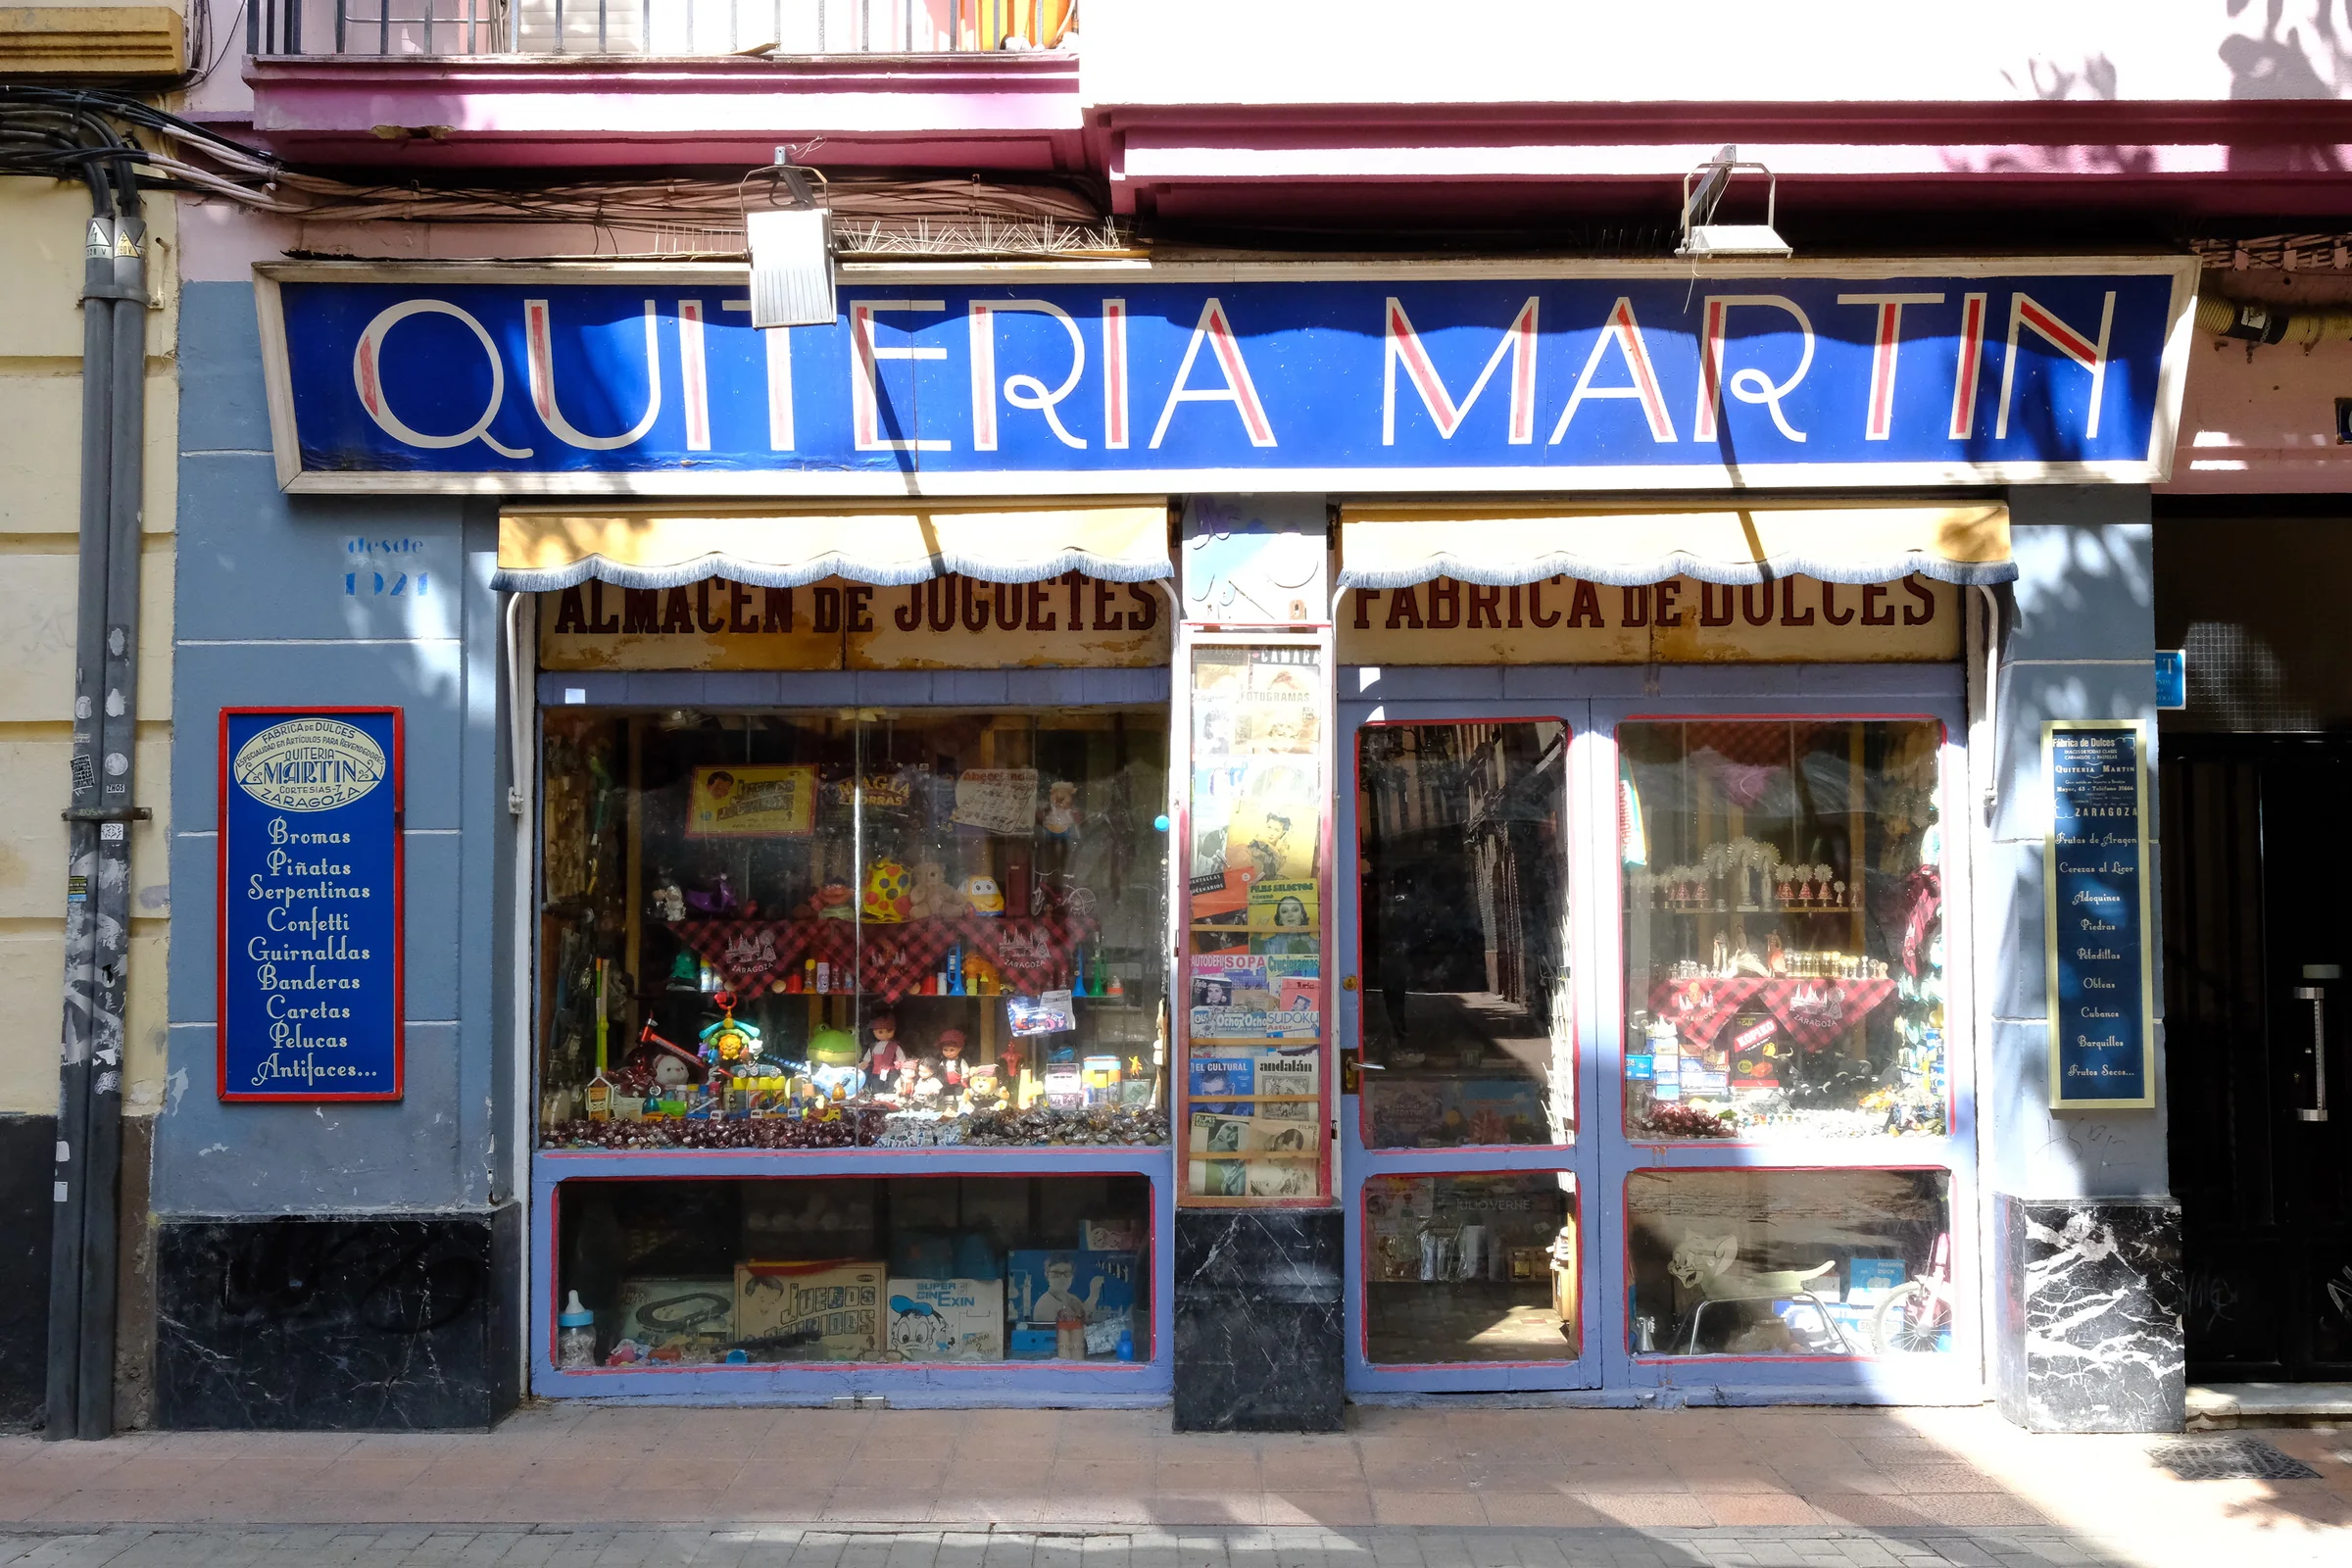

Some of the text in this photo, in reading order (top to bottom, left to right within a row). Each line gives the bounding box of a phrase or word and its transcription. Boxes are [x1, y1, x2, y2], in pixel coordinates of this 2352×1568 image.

[352, 291, 2117, 459] QUITERIA MARTIN
[347, 537, 423, 555] desde
[555, 574, 1159, 634] ALMACEN DE JUGUETES
[1353, 567, 1936, 629] FABRICA DE DULCES
[1241, 691, 1310, 703] FOTOGRAMAS
[262, 723, 303, 744] FABRICA
[316, 722, 356, 739] DULCES
[2080, 738, 2089, 747] de
[2090, 737, 2116, 748] Dulces
[235, 742, 276, 767] ESPECIALIDAD
[322, 736, 339, 745] PARA
[339, 738, 386, 765] REVENDEDORES
[283, 747, 335, 761] QUITERIA
[264, 760, 358, 784] MARTIN
[2055, 764, 2135, 774] QUITERIA MARTIN
[839, 775, 910, 798] MAGIA
[261, 787, 362, 808] ZARAGOZA
[2075, 807, 2138, 817] ZARAGOZA
[268, 815, 351, 846] Bromas
[2054, 831, 2086, 847] Frutas
[2089, 832, 2100, 845] de
[267, 847, 352, 877] Piñatas
[2059, 860, 2134, 876] Cerezas al Licor
[247, 873, 370, 908] Serpentinas
[1250, 882, 1314, 894] FILMS SELECTOS
[2072, 890, 2121, 906] Adoquines
[267, 906, 350, 941] Confetti
[2080, 917, 2116, 931] Piedras
[247, 935, 370, 962] Guirnaldas
[2076, 947, 2121, 960] Peladillas
[731, 961, 774, 973] ZARAGOZA
[1004, 957, 1047, 969] ZARAGOZA
[1226, 956, 1266, 968] SOPA
[1267, 956, 1319, 973] Crucigramas
[257, 961, 361, 991] Banderas
[2082, 977, 2116, 990] Obleas
[266, 994, 351, 1020] Caretas
[2081, 1005, 2120, 1019] Cubanos
[1267, 1012, 1319, 1024] SUDOKU
[1793, 1014, 1838, 1029] ZARAGOZA
[269, 1019, 348, 1049] Pelucas
[1736, 1019, 1777, 1049] KOPIKO
[2077, 1035, 2124, 1051] Barquillos
[1196, 1062, 1249, 1072] EL CULTURAL
[1259, 1059, 1313, 1073] andalán
[2067, 1063, 2098, 1077] Frutos
[1456, 1199, 1532, 1211] JULIO VERNE
[916, 1282, 956, 1291] SUPER
[780, 1283, 876, 1325] JUEGOS
